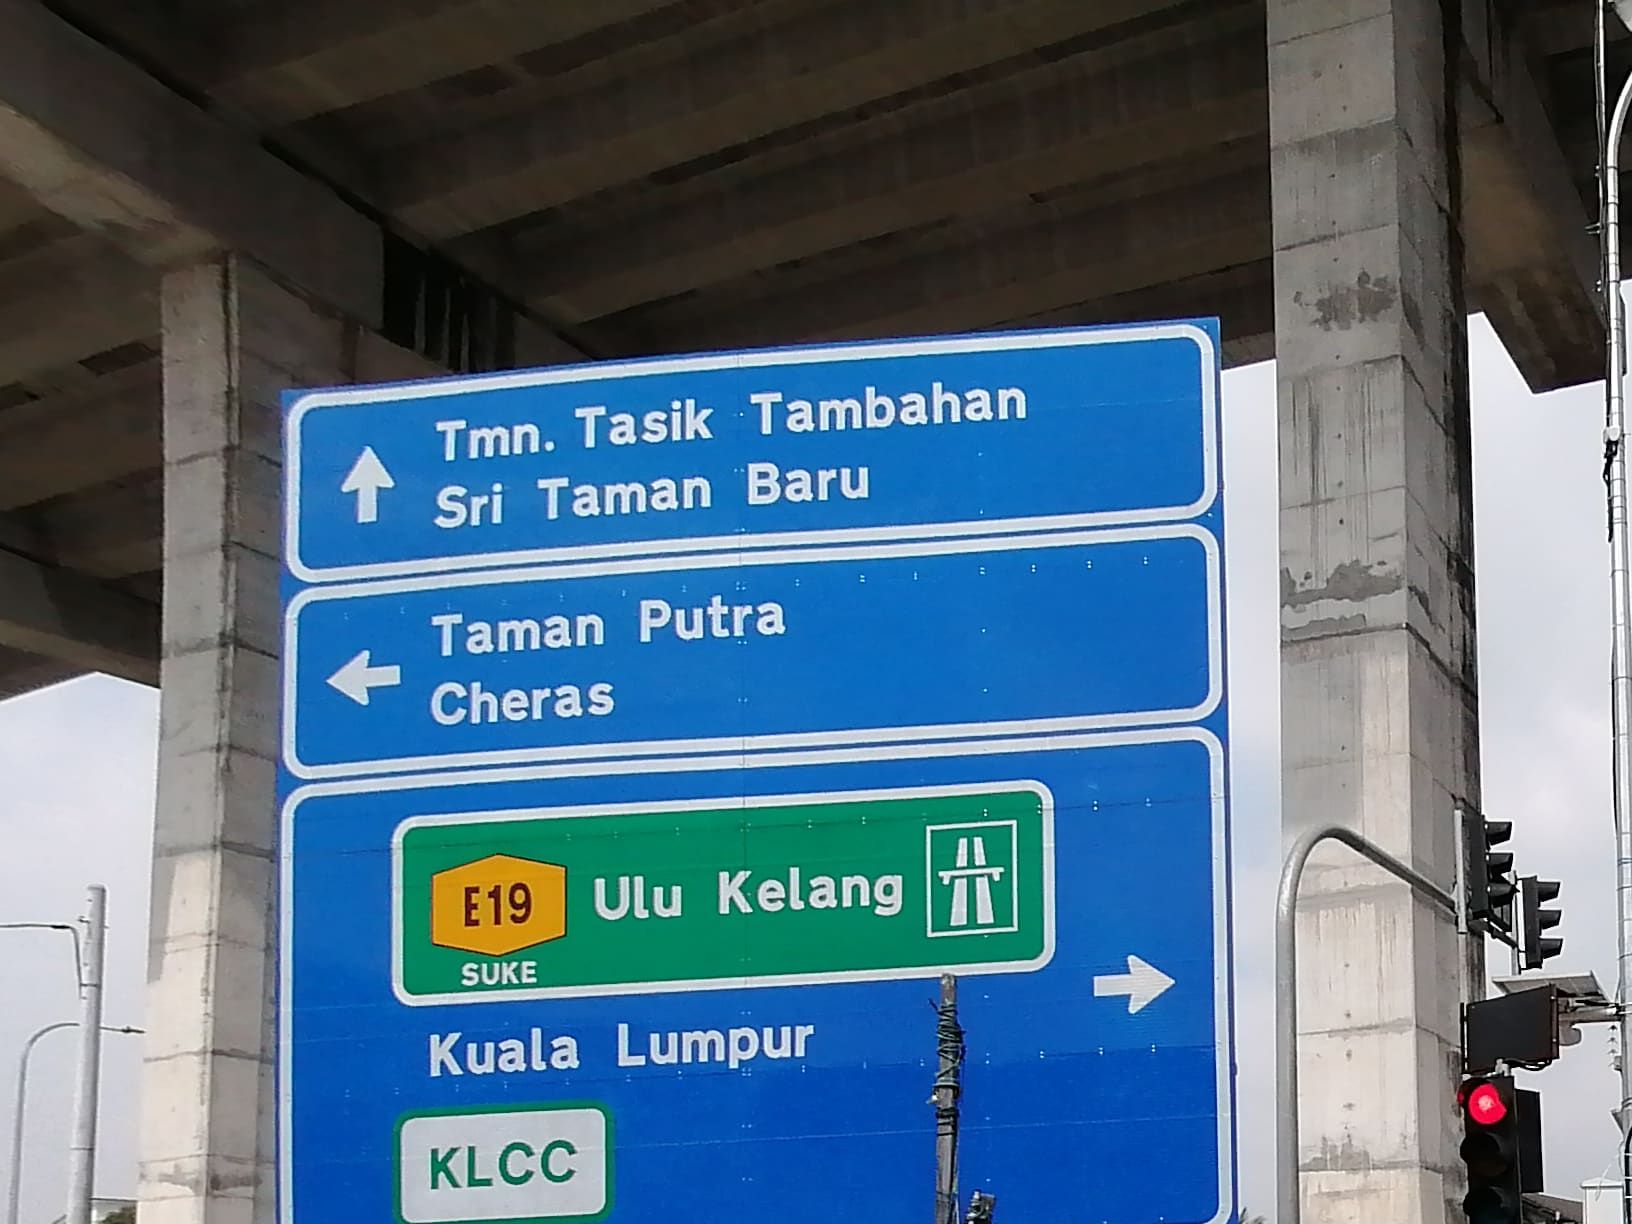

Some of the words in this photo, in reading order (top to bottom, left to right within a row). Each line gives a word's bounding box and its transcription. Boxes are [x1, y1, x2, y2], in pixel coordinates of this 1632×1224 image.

[435, 419, 555, 461] Tmn.
[574, 398, 714, 448] Tasik
[750, 381, 1026, 435] Tambahan
[433, 484, 503, 530] Sri
[537, 476, 711, 521] Taman
[747, 462, 869, 506] Baru
[431, 613, 604, 658] Taman
[639, 595, 786, 643] Putra
[430, 681, 615, 726] Cheras
[464, 882, 532, 927] E19
[594, 875, 682, 921] Ulu
[718, 867, 903, 916] Kelang
[461, 961, 538, 986] SUKE
[430, 1027, 580, 1077] Kuala
[617, 1023, 814, 1069] Lumpur
[430, 1139, 578, 1190] KLCC
